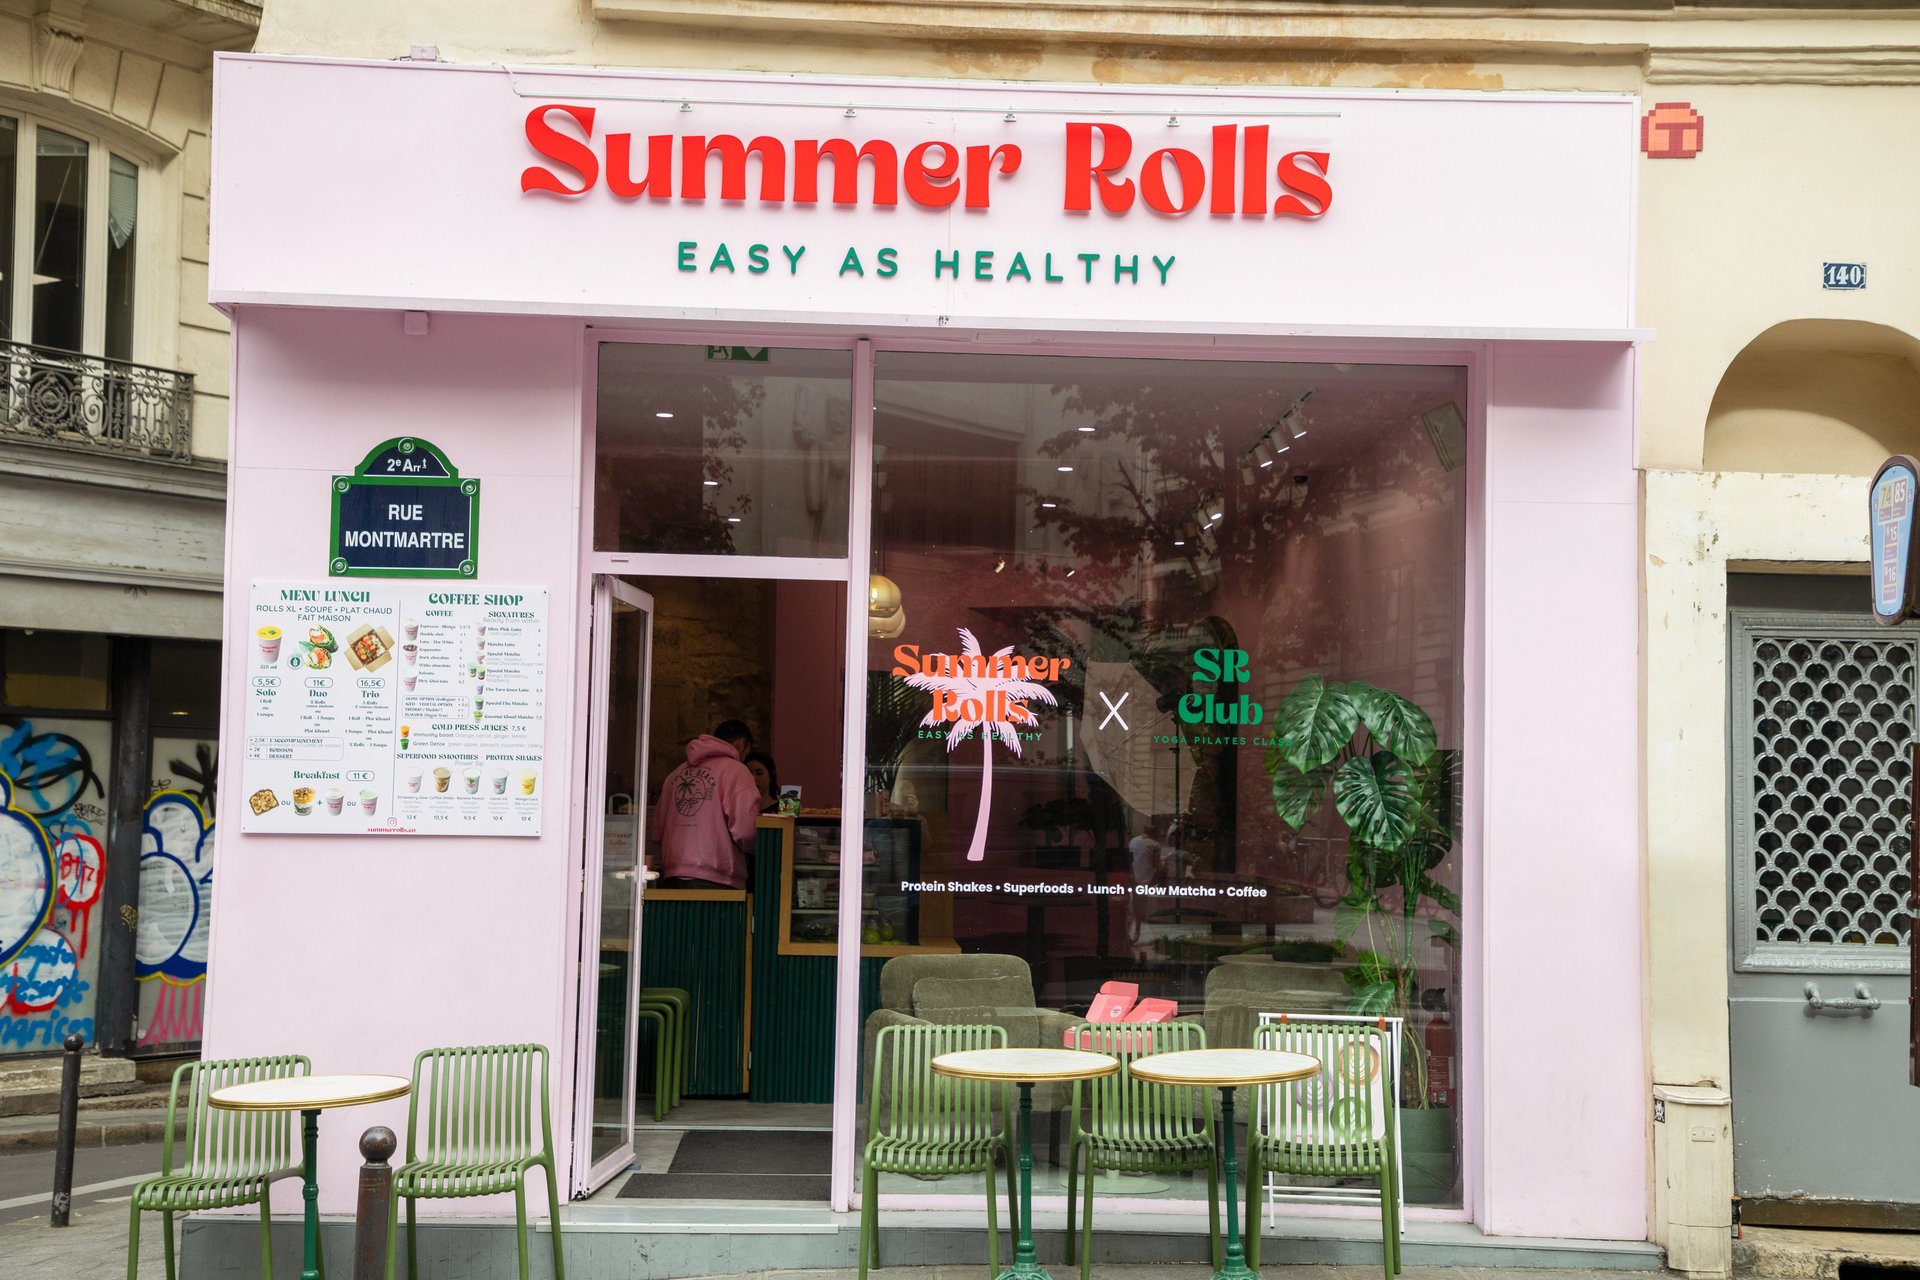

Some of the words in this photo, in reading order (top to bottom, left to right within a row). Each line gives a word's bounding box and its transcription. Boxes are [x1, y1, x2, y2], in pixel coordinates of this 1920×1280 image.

[521, 104, 1022, 208] Summer
[1064, 122, 1332, 216] Rolls
[678, 241, 805, 274] EASY
[839, 247, 898, 277] AS
[935, 249, 1175, 285] HEALTHY
[1826, 265, 1862, 285] 140
[1881, 486, 1892, 506] 74
[1894, 481, 1905, 504] 85
[388, 504, 423, 520] RUE
[345, 531, 464, 548] MONTMARTRE
[280, 589, 320, 601] MENU
[325, 590, 370, 602] LUNCH
[428, 593, 480, 605] COFFEE
[484, 594, 523, 606] SHOP
[256, 604, 284, 612] ROLLS
[286, 605, 296, 613] XL
[304, 605, 332, 613] SOUPE
[340, 606, 360, 614] PLAT
[363, 607, 393, 615] CHAUD
[318, 614, 351, 622] MAISON
[892, 644, 1071, 682] Summer
[1192, 648, 1251, 683] SR
[256, 689, 276, 697] Solo
[309, 689, 328, 697] Duo
[361, 690, 380, 698] Trio
[933, 689, 1029, 724] Rolls
[1178, 693, 1263, 725] Club
[917, 730, 949, 740] EASY
[957, 731, 974, 740] AS
[981, 731, 1042, 741] HEALTHY
[1153, 735, 1188, 744] YOGA
[1194, 736, 1246, 745] PILATES
[1253, 737, 1295, 747] CLASS
[293, 771, 340, 779] Breakfast
[696, 769, 716, 789] BEACH
[901, 880, 945, 892] Protein
[947, 881, 993, 893] Shakes
[1003, 882, 1074, 896] Superfoods
[1087, 884, 1125, 895] Lunch
[1135, 884, 1166, 896] Glow
[1168, 885, 1216, 896] Matcha
[1226, 886, 1268, 898] Coffee
